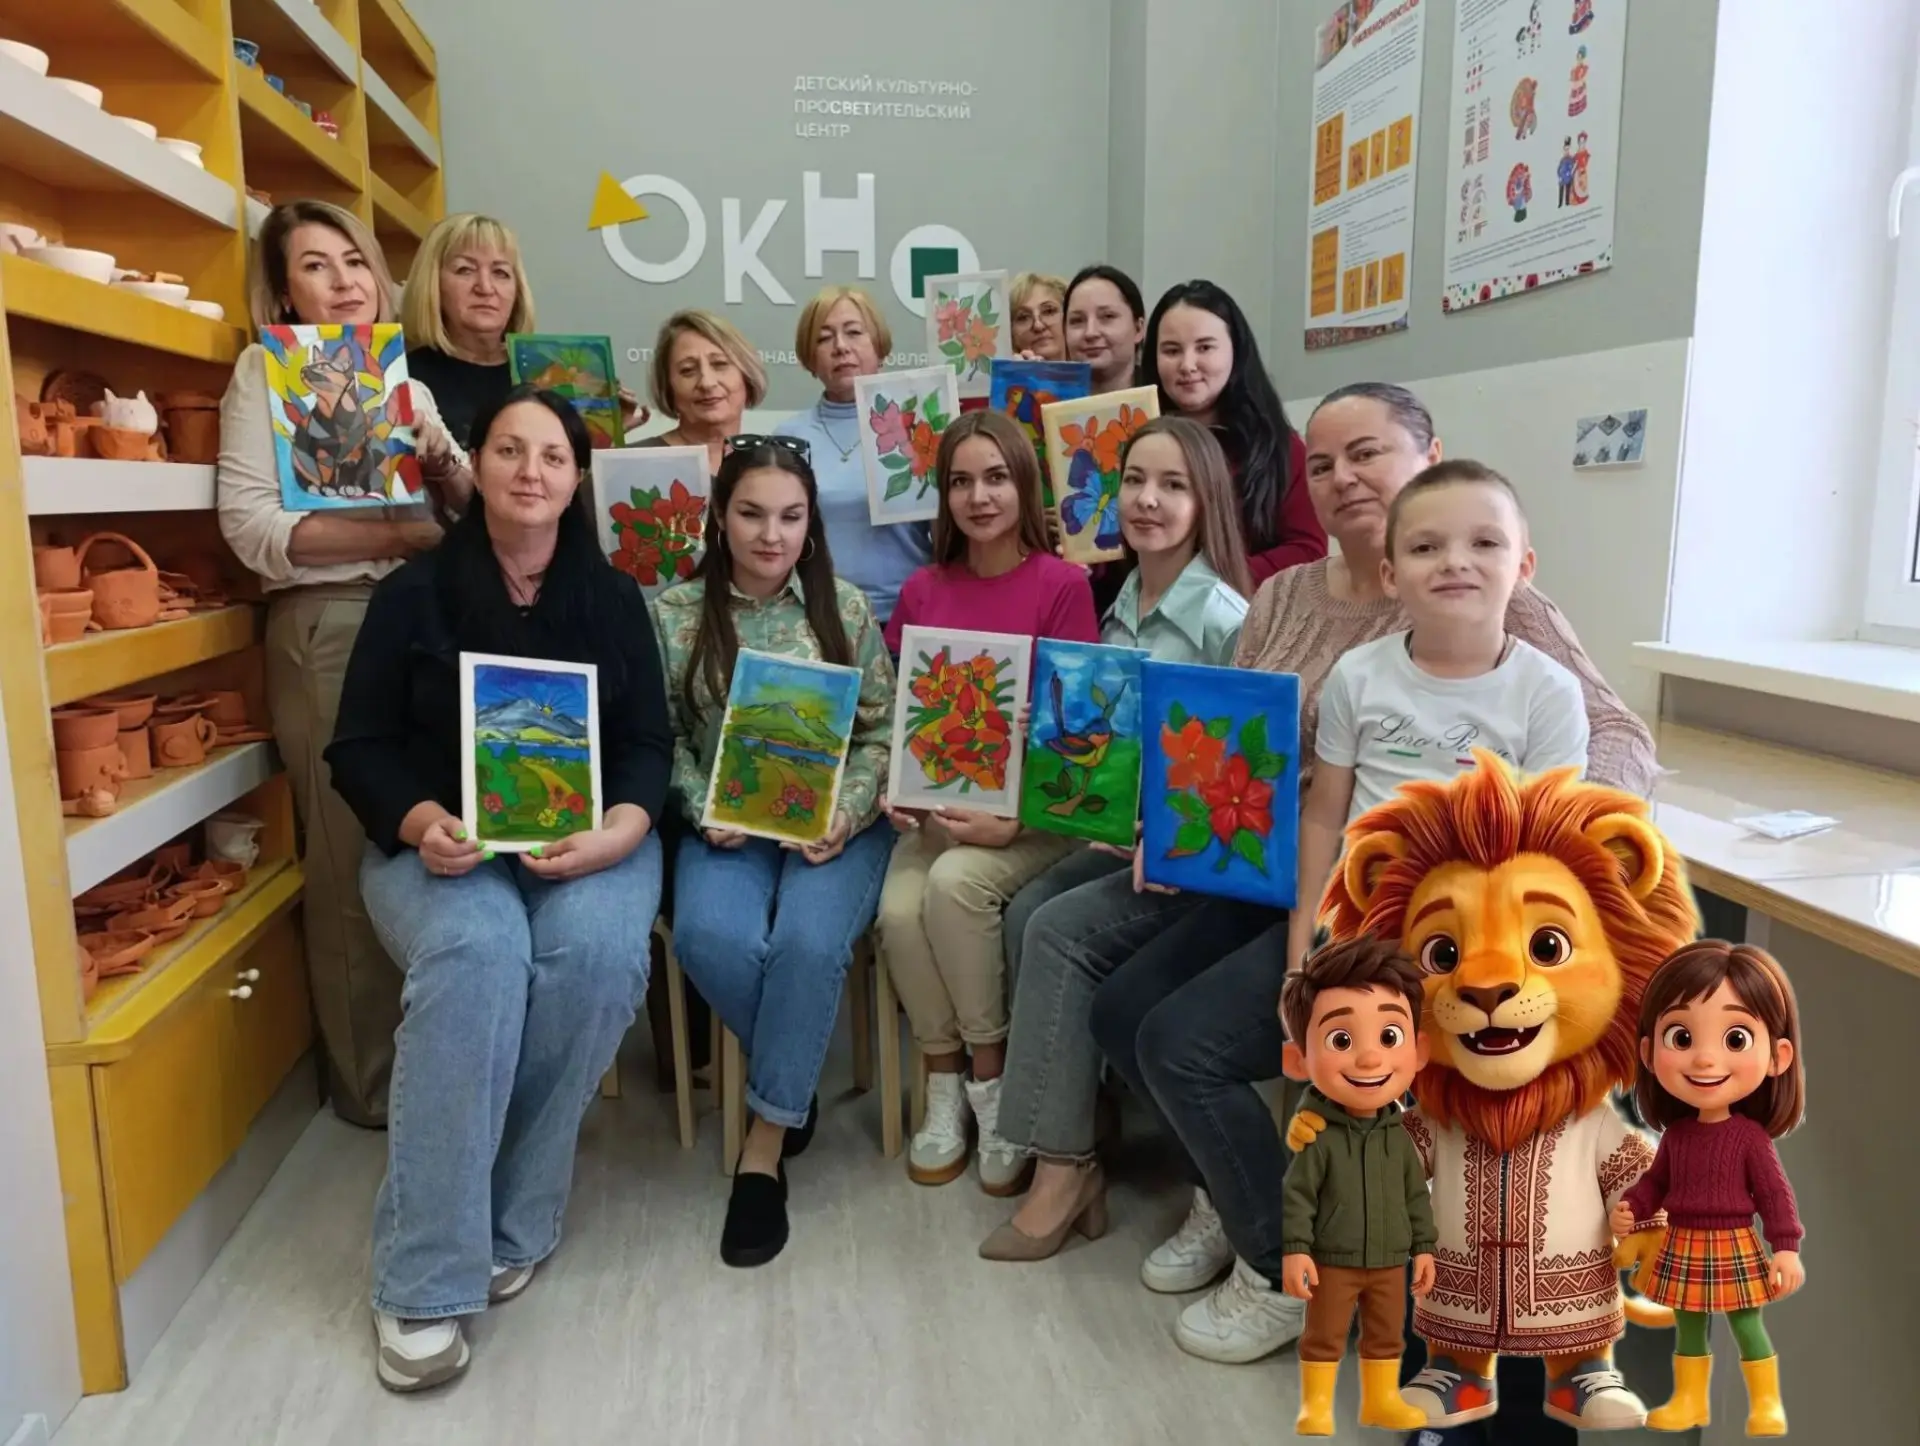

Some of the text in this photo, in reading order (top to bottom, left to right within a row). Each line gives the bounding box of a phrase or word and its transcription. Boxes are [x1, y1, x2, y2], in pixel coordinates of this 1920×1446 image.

[794, 75, 978, 96] ДЕТСКИЙ КУЛЬТУРНО-
[794, 99, 971, 119] ПРОСВЕТИТЕЛЬСКИЙ
[796, 122, 851, 138] ЦЕНТР
[600, 171, 981, 319] ОКНО
[627, 348, 655, 362] ОТ
[884, 352, 928, 367] ОВЛЯ
[1374, 713, 1434, 748] Loro
